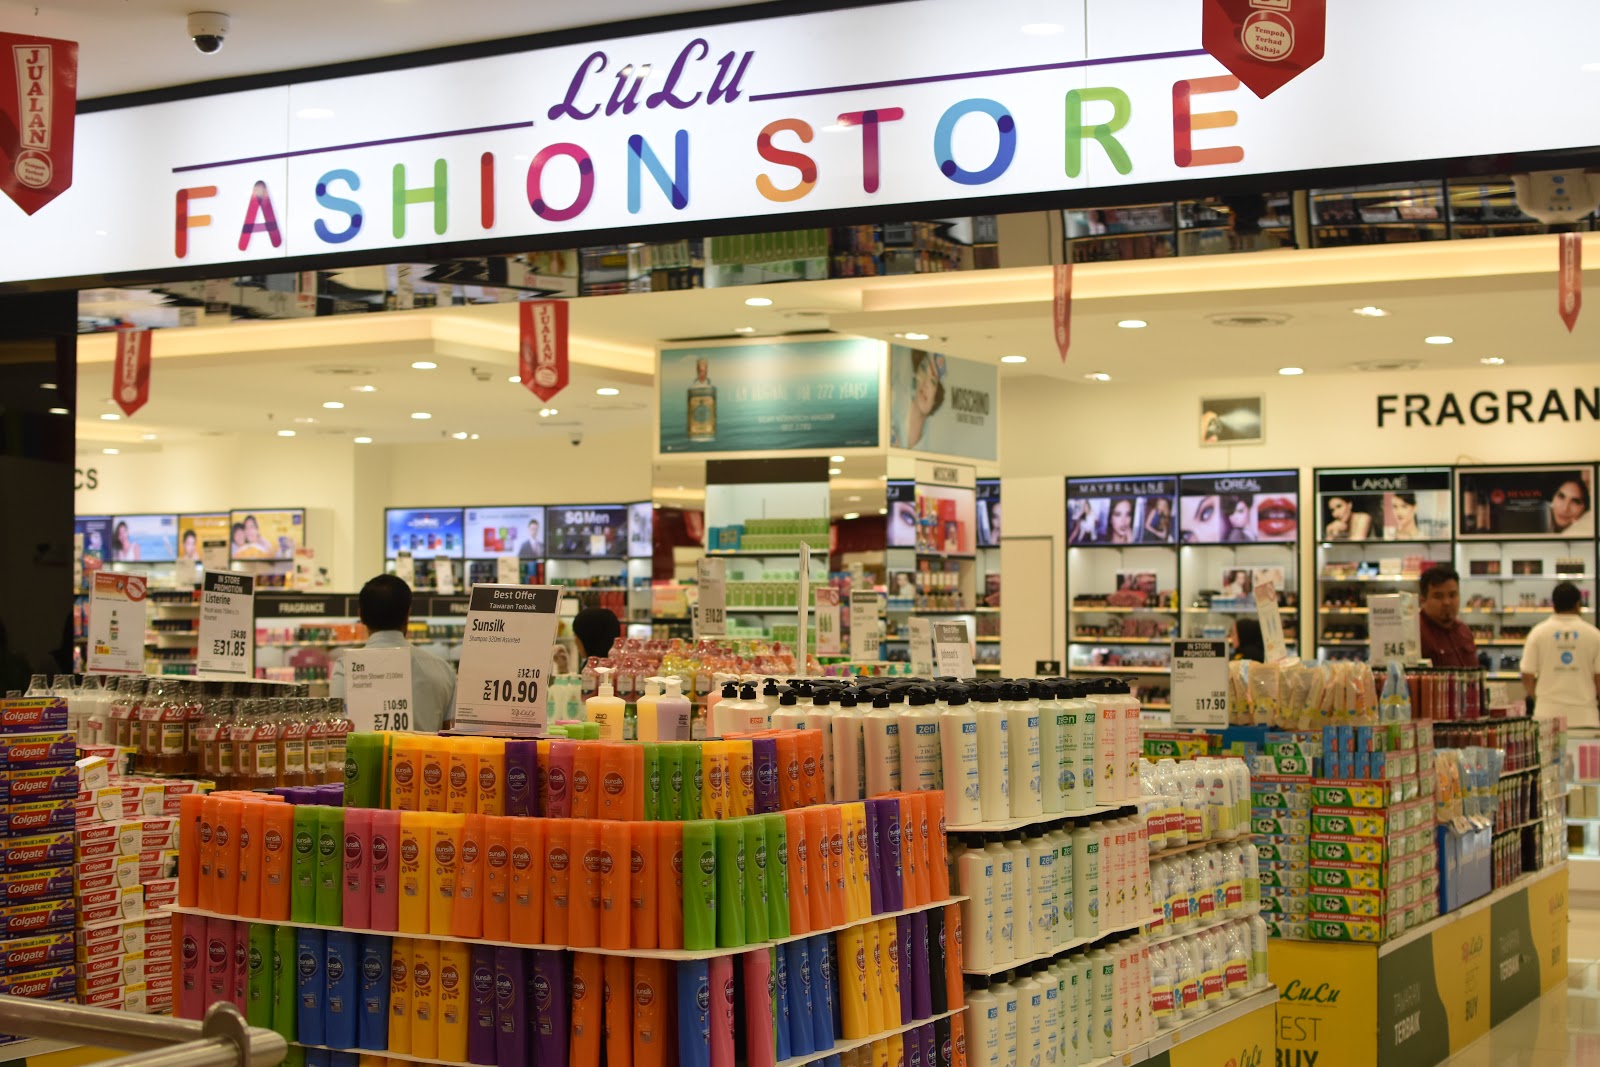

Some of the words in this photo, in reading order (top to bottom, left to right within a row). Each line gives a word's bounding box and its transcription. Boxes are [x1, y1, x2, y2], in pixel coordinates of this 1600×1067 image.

[1255, 26, 1285, 38] Tempoh
[1256, 36, 1282, 46] Terhad
[1255, 44, 1280, 54] Sahaja
[547, 38, 755, 121] LuLu
[26, 50, 46, 144] JUALAN
[24, 161, 46, 171] Tempoh
[174, 129, 690, 259] FASHION
[755, 75, 1245, 203] STORE
[540, 305, 552, 360] JUALAN
[1377, 386, 1600, 427] FRAGRAN
[225, 576, 240, 584] STORE
[214, 583, 243, 594] PROMOTION
[205, 593, 231, 605] Listerine
[494, 590, 513, 600] Best
[515, 590, 536, 600] Offer
[472, 618, 505, 632] Sunsilk
[469, 635, 488, 643] Shampoo
[502, 636, 520, 644] Assorted
[214, 640, 220, 654] RM
[220, 640, 245, 656] 31.85
[352, 662, 365, 672] Zen
[1177, 661, 1193, 669] Darlie
[522, 668, 540, 678] 12.10
[483, 680, 492, 700] RM
[493, 680, 538, 703] 10.90
[388, 699, 407, 710] 10.90
[1201, 699, 1226, 710] 17.90
[4, 711, 38, 722] Colgate
[166, 706, 184, 716] 30
[327, 721, 348, 732] 30
[383, 713, 408, 730] 7.80
[258, 724, 276, 736] 30
[288, 723, 304, 734] 30
[312, 722, 327, 733] 30
[10, 748, 45, 758] Colgate
[13, 781, 48, 791] Colgate
[12, 814, 47, 825] Colgate
[87, 829, 109, 838] Colgate
[142, 837, 164, 846] Colgate
[8, 848, 44, 860] Colgate
[85, 862, 106, 871] Colgate
[8, 883, 44, 894] Colgate
[88, 894, 111, 902] Colgate
[10, 916, 45, 927] Colgate
[92, 928, 113, 937] Colgate
[8, 951, 44, 962] Colgate
[11, 983, 47, 995] Colgate
[1280, 980, 1340, 1003] LuLu
[1280, 1016, 1322, 1042] EST
